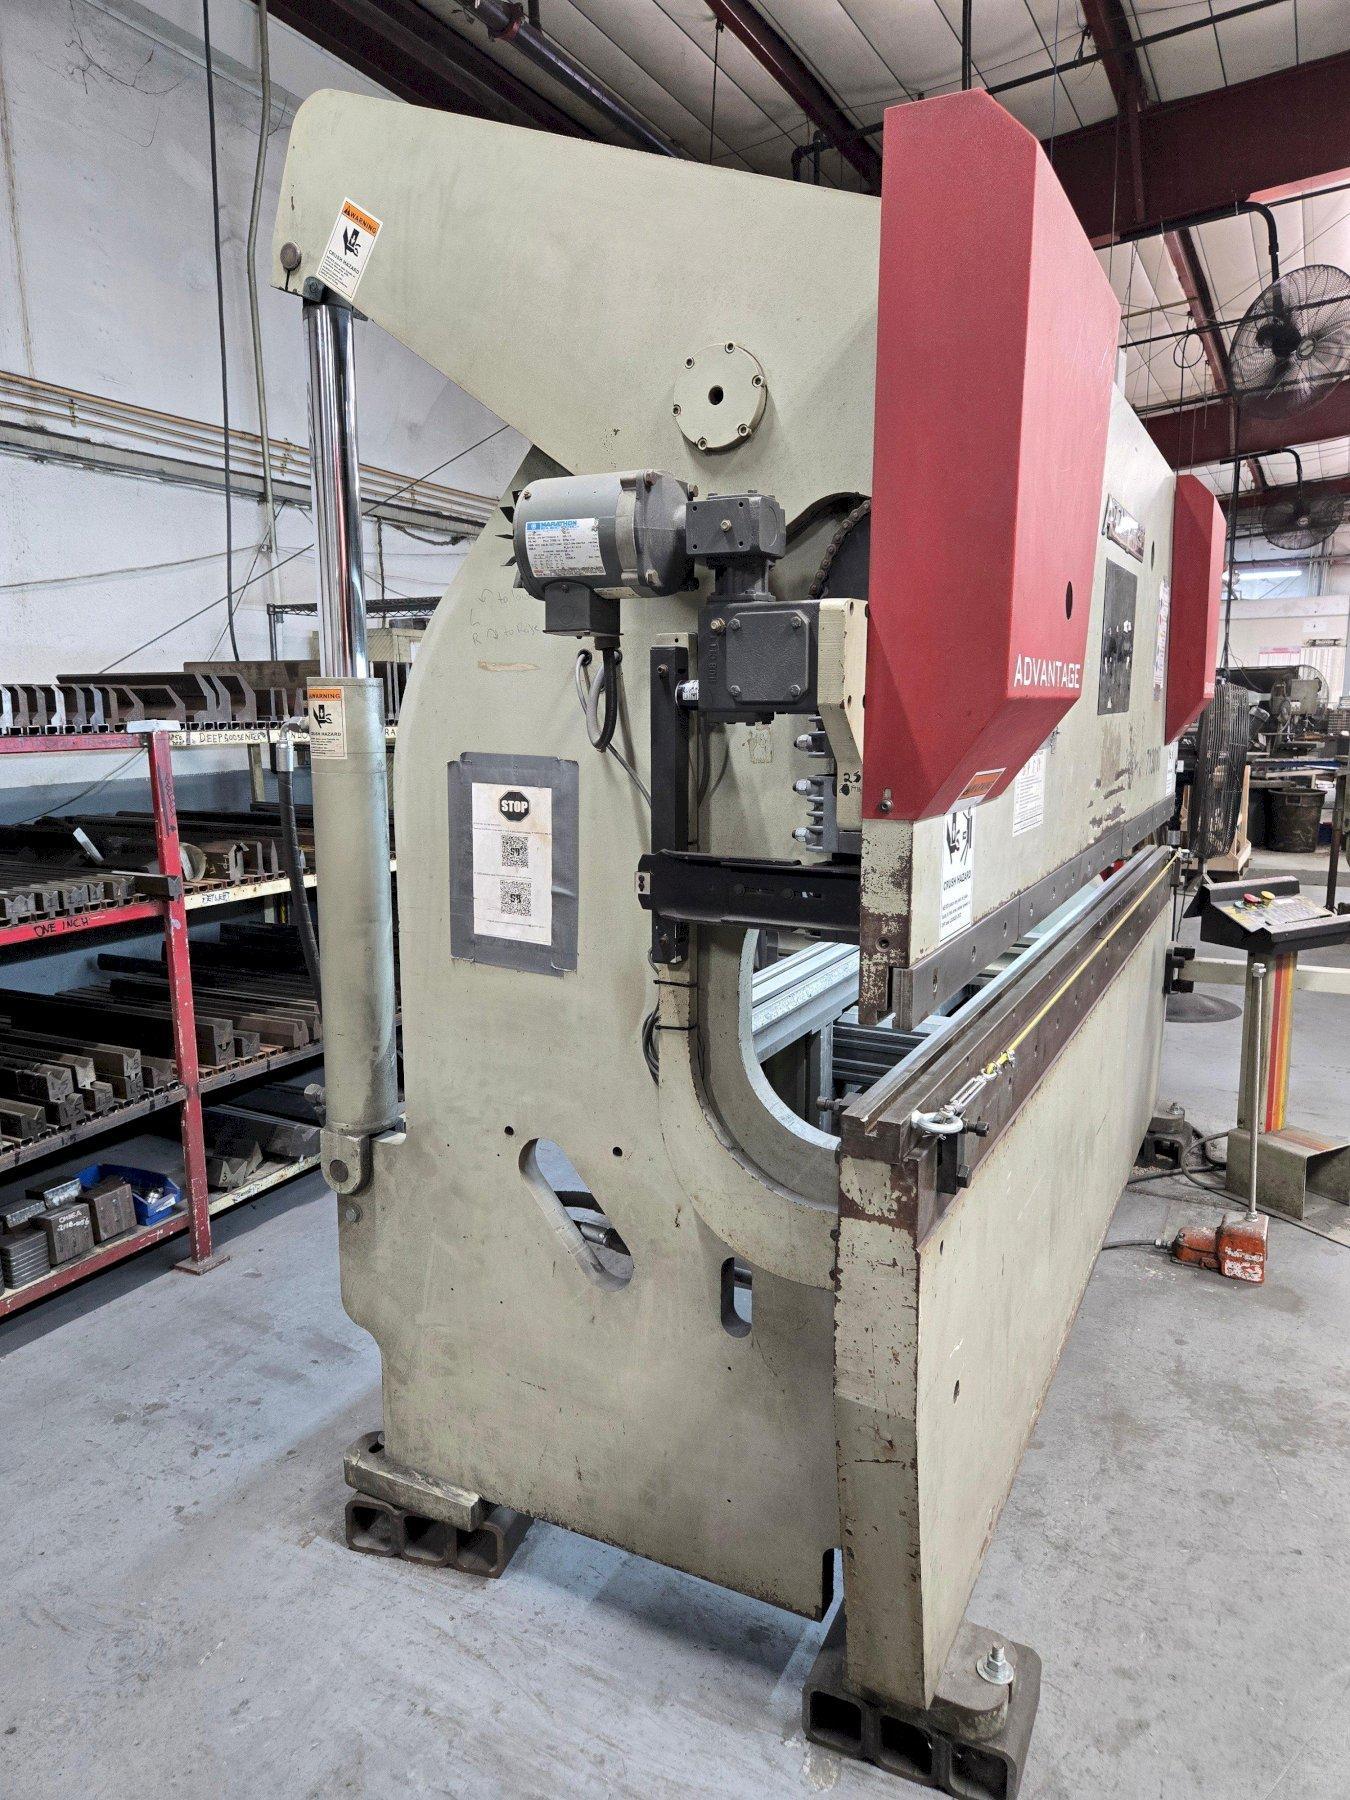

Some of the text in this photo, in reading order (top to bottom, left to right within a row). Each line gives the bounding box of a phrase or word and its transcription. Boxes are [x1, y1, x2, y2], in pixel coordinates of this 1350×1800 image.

[350, 212, 377, 234] WARNING
[343, 260, 360, 275] HAZARD
[1013, 653, 1081, 689] ADVANTAGE
[500, 799, 529, 814] STOP
[33, 917, 90, 938] ONE INCH
